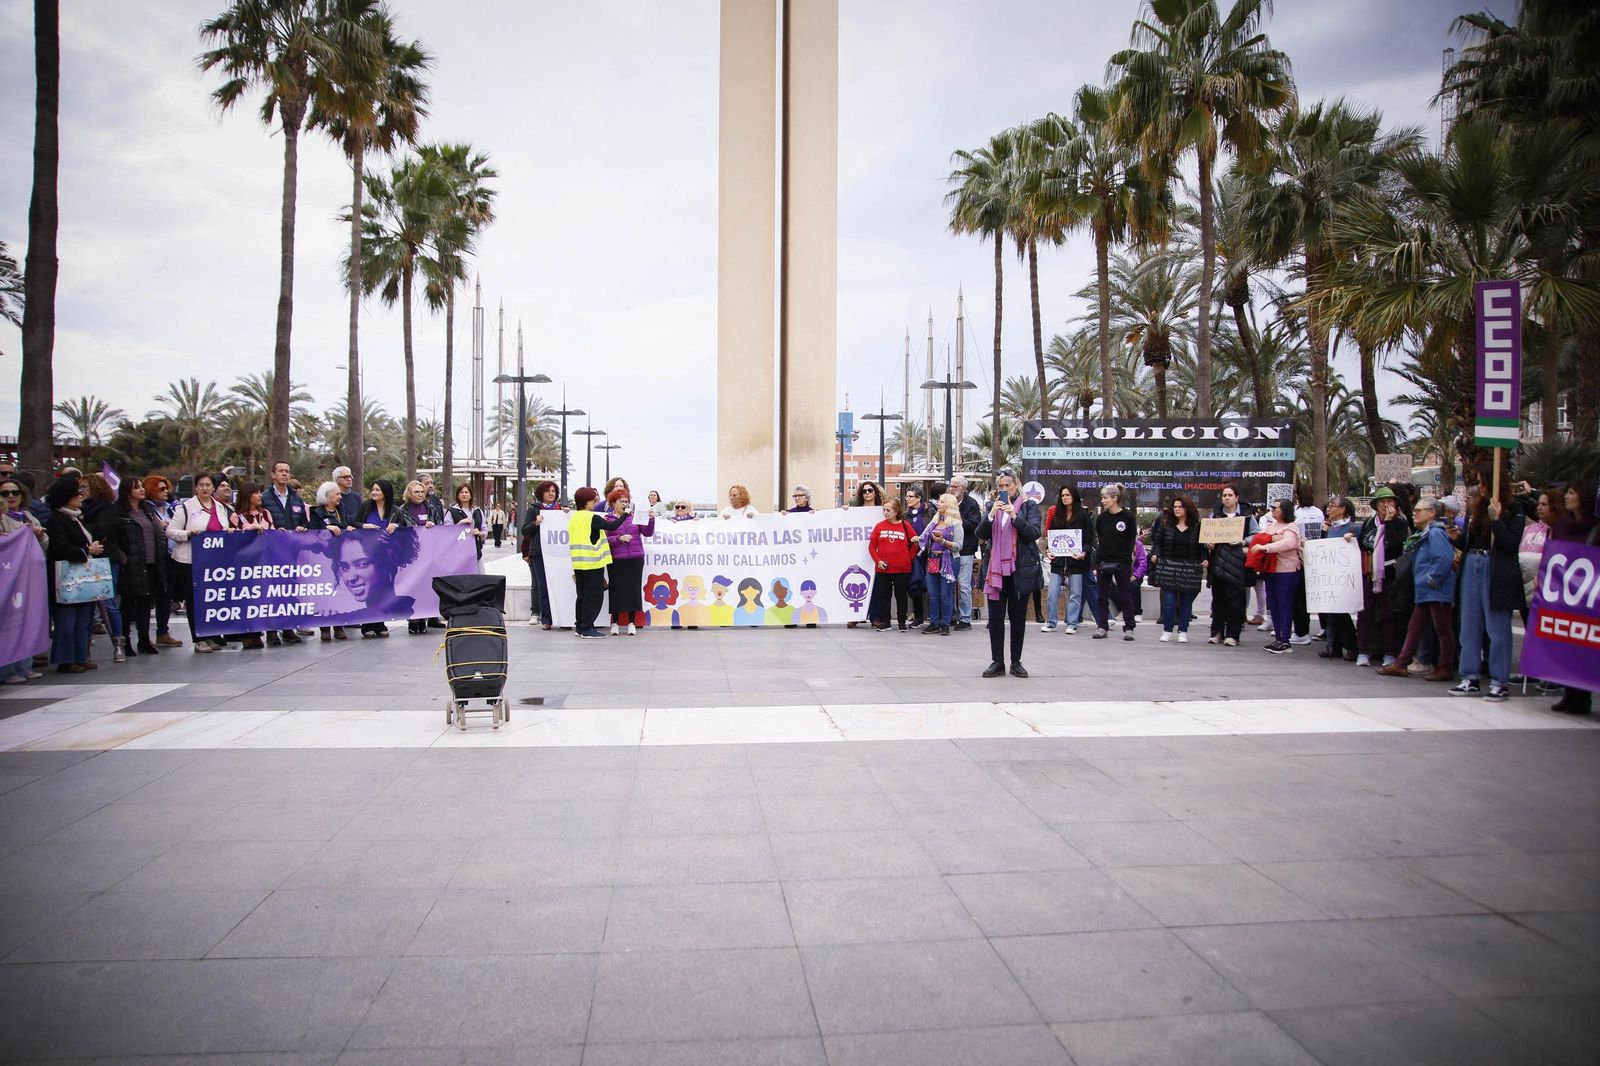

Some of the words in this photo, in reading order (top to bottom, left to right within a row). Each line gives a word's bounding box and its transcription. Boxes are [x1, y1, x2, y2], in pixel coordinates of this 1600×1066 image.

[1483, 288, 1512, 411] CCOO
[1253, 451, 1289, 460] alquiler
[202, 537, 224, 548] 8M
[547, 530, 570, 545] NO
[705, 531, 768, 546] CONTRA
[773, 528, 803, 544] LAS
[808, 526, 873, 543] MUJERE
[654, 554, 714, 566] PARAMOS
[717, 553, 729, 565] NI
[733, 553, 796, 566] CALLAMOS
[203, 567, 236, 582] LOS
[240, 564, 322, 580] DERECHOS
[204, 588, 227, 602] DE
[231, 585, 262, 600] LAS
[266, 582, 338, 598] MUJERES,
[205, 606, 242, 622] POR
